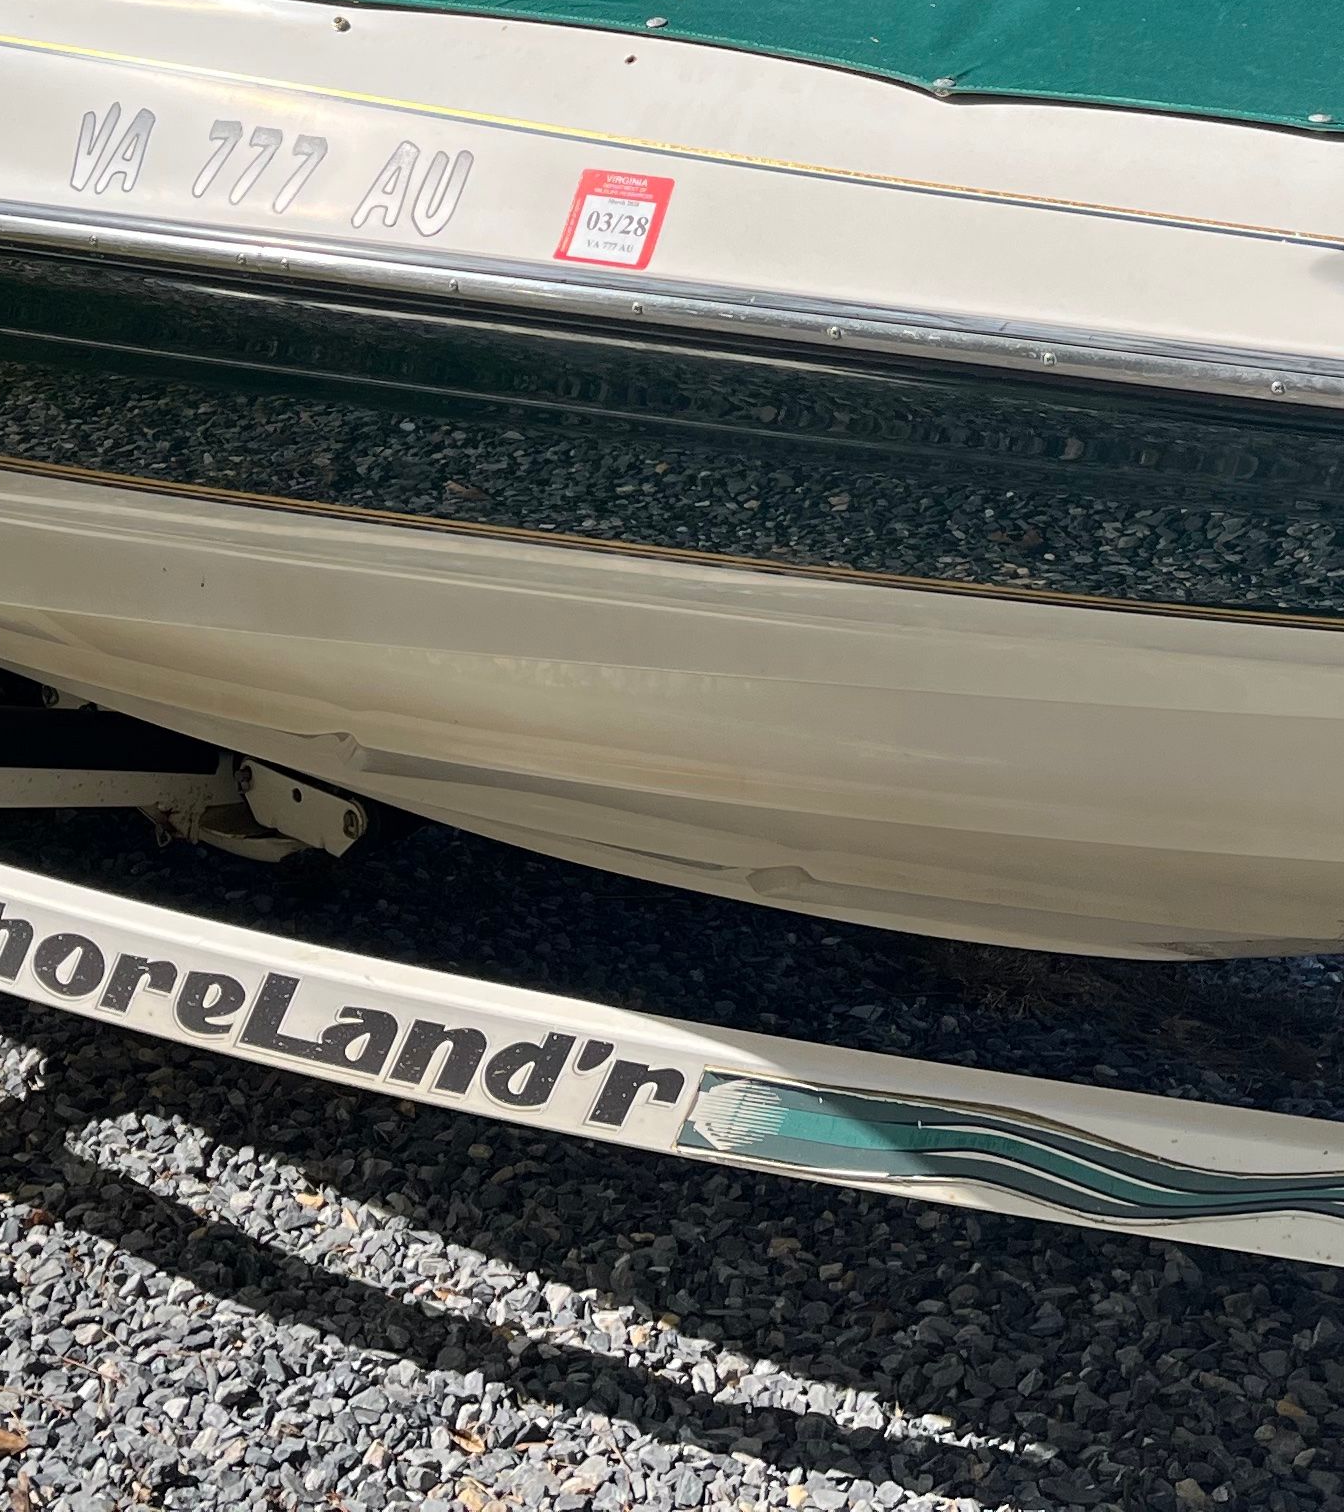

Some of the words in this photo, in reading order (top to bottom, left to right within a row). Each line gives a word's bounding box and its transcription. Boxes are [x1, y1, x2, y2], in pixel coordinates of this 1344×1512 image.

[70, 101, 156, 194] VA
[192, 119, 328, 214] 777
[351, 140, 474, 237] AU
[606, 174, 648, 187] VIRGINIA
[586, 210, 649, 237] 03/28
